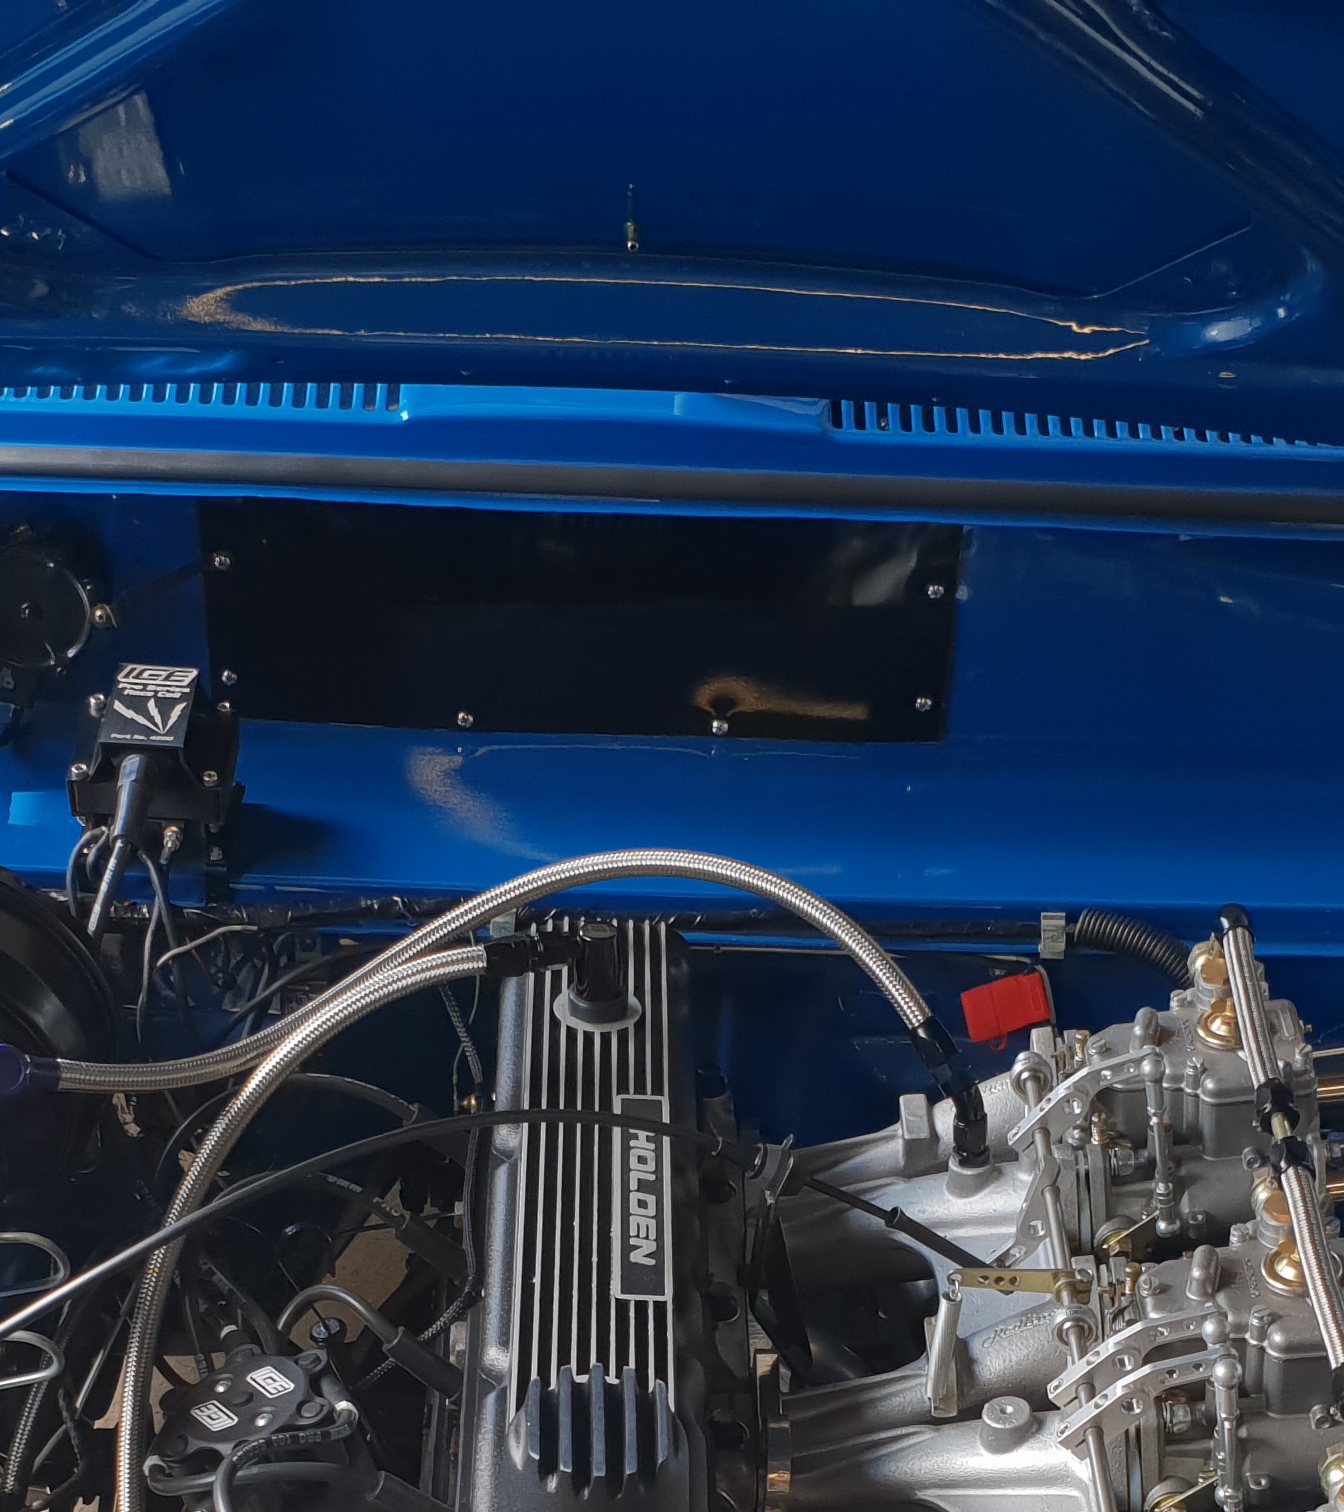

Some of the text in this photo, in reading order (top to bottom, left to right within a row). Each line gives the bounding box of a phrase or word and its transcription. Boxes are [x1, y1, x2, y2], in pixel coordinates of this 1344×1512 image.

[117, 664, 199, 686] ICE
[628, 1128, 656, 1266] HOLDEN
[245, 1365, 296, 1399] ICE
[190, 1400, 238, 1432] ICE
